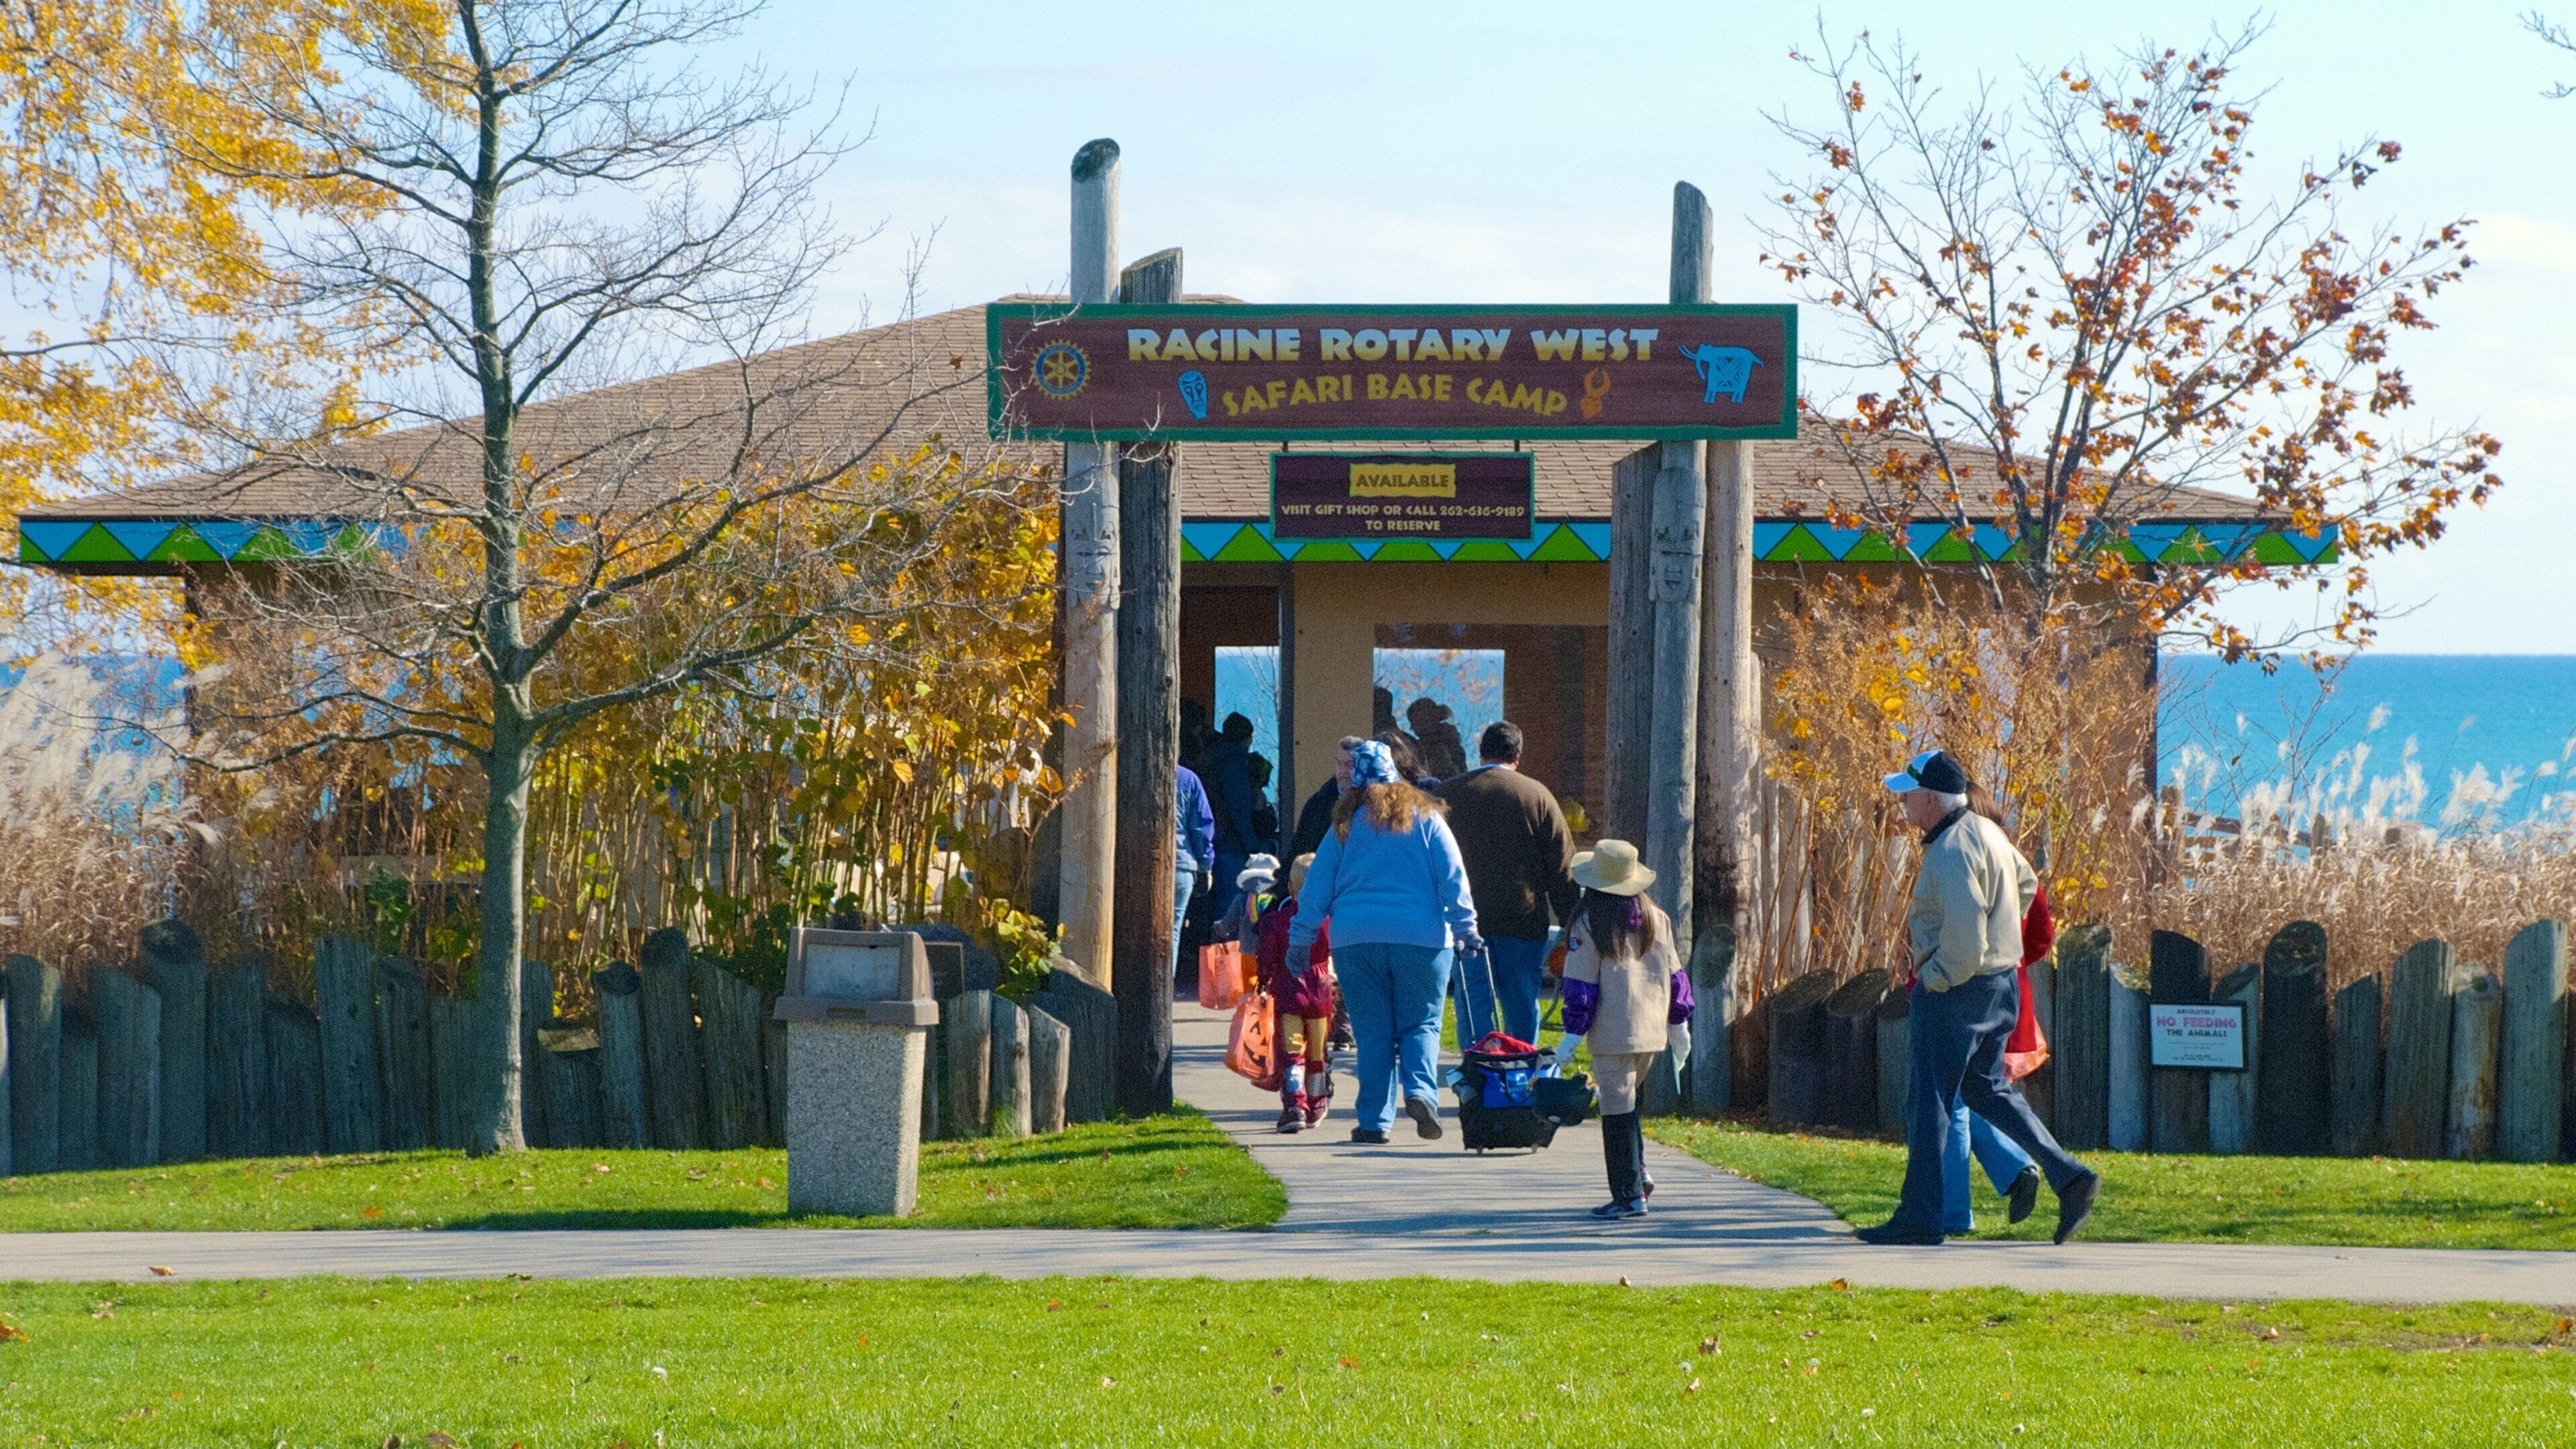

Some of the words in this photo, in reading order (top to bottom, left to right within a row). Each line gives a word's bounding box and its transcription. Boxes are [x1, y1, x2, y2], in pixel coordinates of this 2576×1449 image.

[1127, 327, 1301, 362] RACINE
[1320, 327, 1511, 362] ROTARY
[1530, 327, 1659, 362] WEST
[1222, 373, 1352, 417] SAFARI
[1366, 372, 1454, 402] BASE
[1466, 376, 1568, 416] CAMP
[1356, 474, 1450, 488] AVAILABLE
[1281, 504, 1311, 515] VISIT
[1314, 504, 1343, 515] GIFT
[1346, 504, 1379, 516] SHOP
[1383, 504, 1401, 516] OR
[1405, 505, 1437, 516] CALL
[1440, 505, 1525, 517] 262-636-9189
[1364, 520, 1383, 531] TO
[1387, 520, 1441, 531] RESERVE
[2157, 1016, 2176, 1026] NO
[2183, 1017, 2236, 1028] FEEDING
